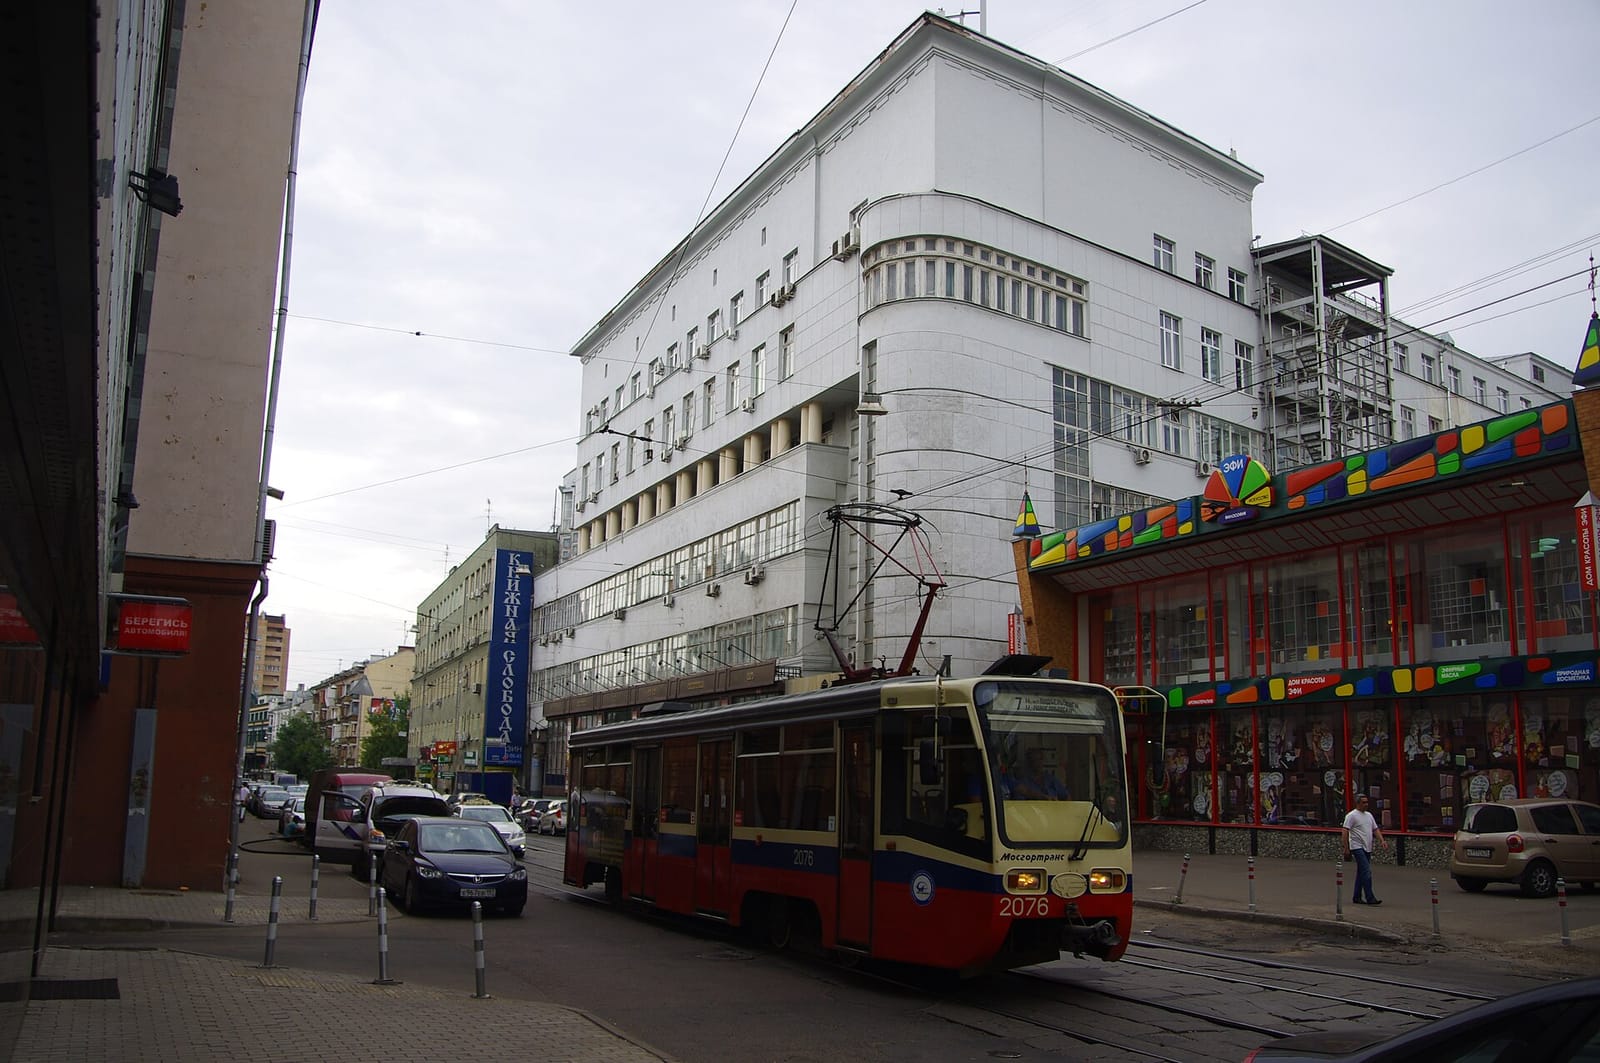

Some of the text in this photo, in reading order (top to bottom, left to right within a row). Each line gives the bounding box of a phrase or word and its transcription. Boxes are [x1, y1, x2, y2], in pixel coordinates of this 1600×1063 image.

[1223, 459, 1243, 473] ЭФИ
[1582, 528, 1591, 565] КРАСОТЫ
[1585, 566, 1594, 586] ДОМ
[503, 553, 521, 644] КНИЖНАЯ
[124, 616, 188, 628] БЕРЕГИСЬ
[1301, 676, 1326, 685] КРАСОТЫ
[499, 650, 515, 743] СЛОБОДА
[1288, 687, 1302, 695] ЭФИ
[1015, 697, 1021, 710] 7
[1000, 852, 1065, 862] Мосгортранс
[1000, 897, 1049, 916] 2076
